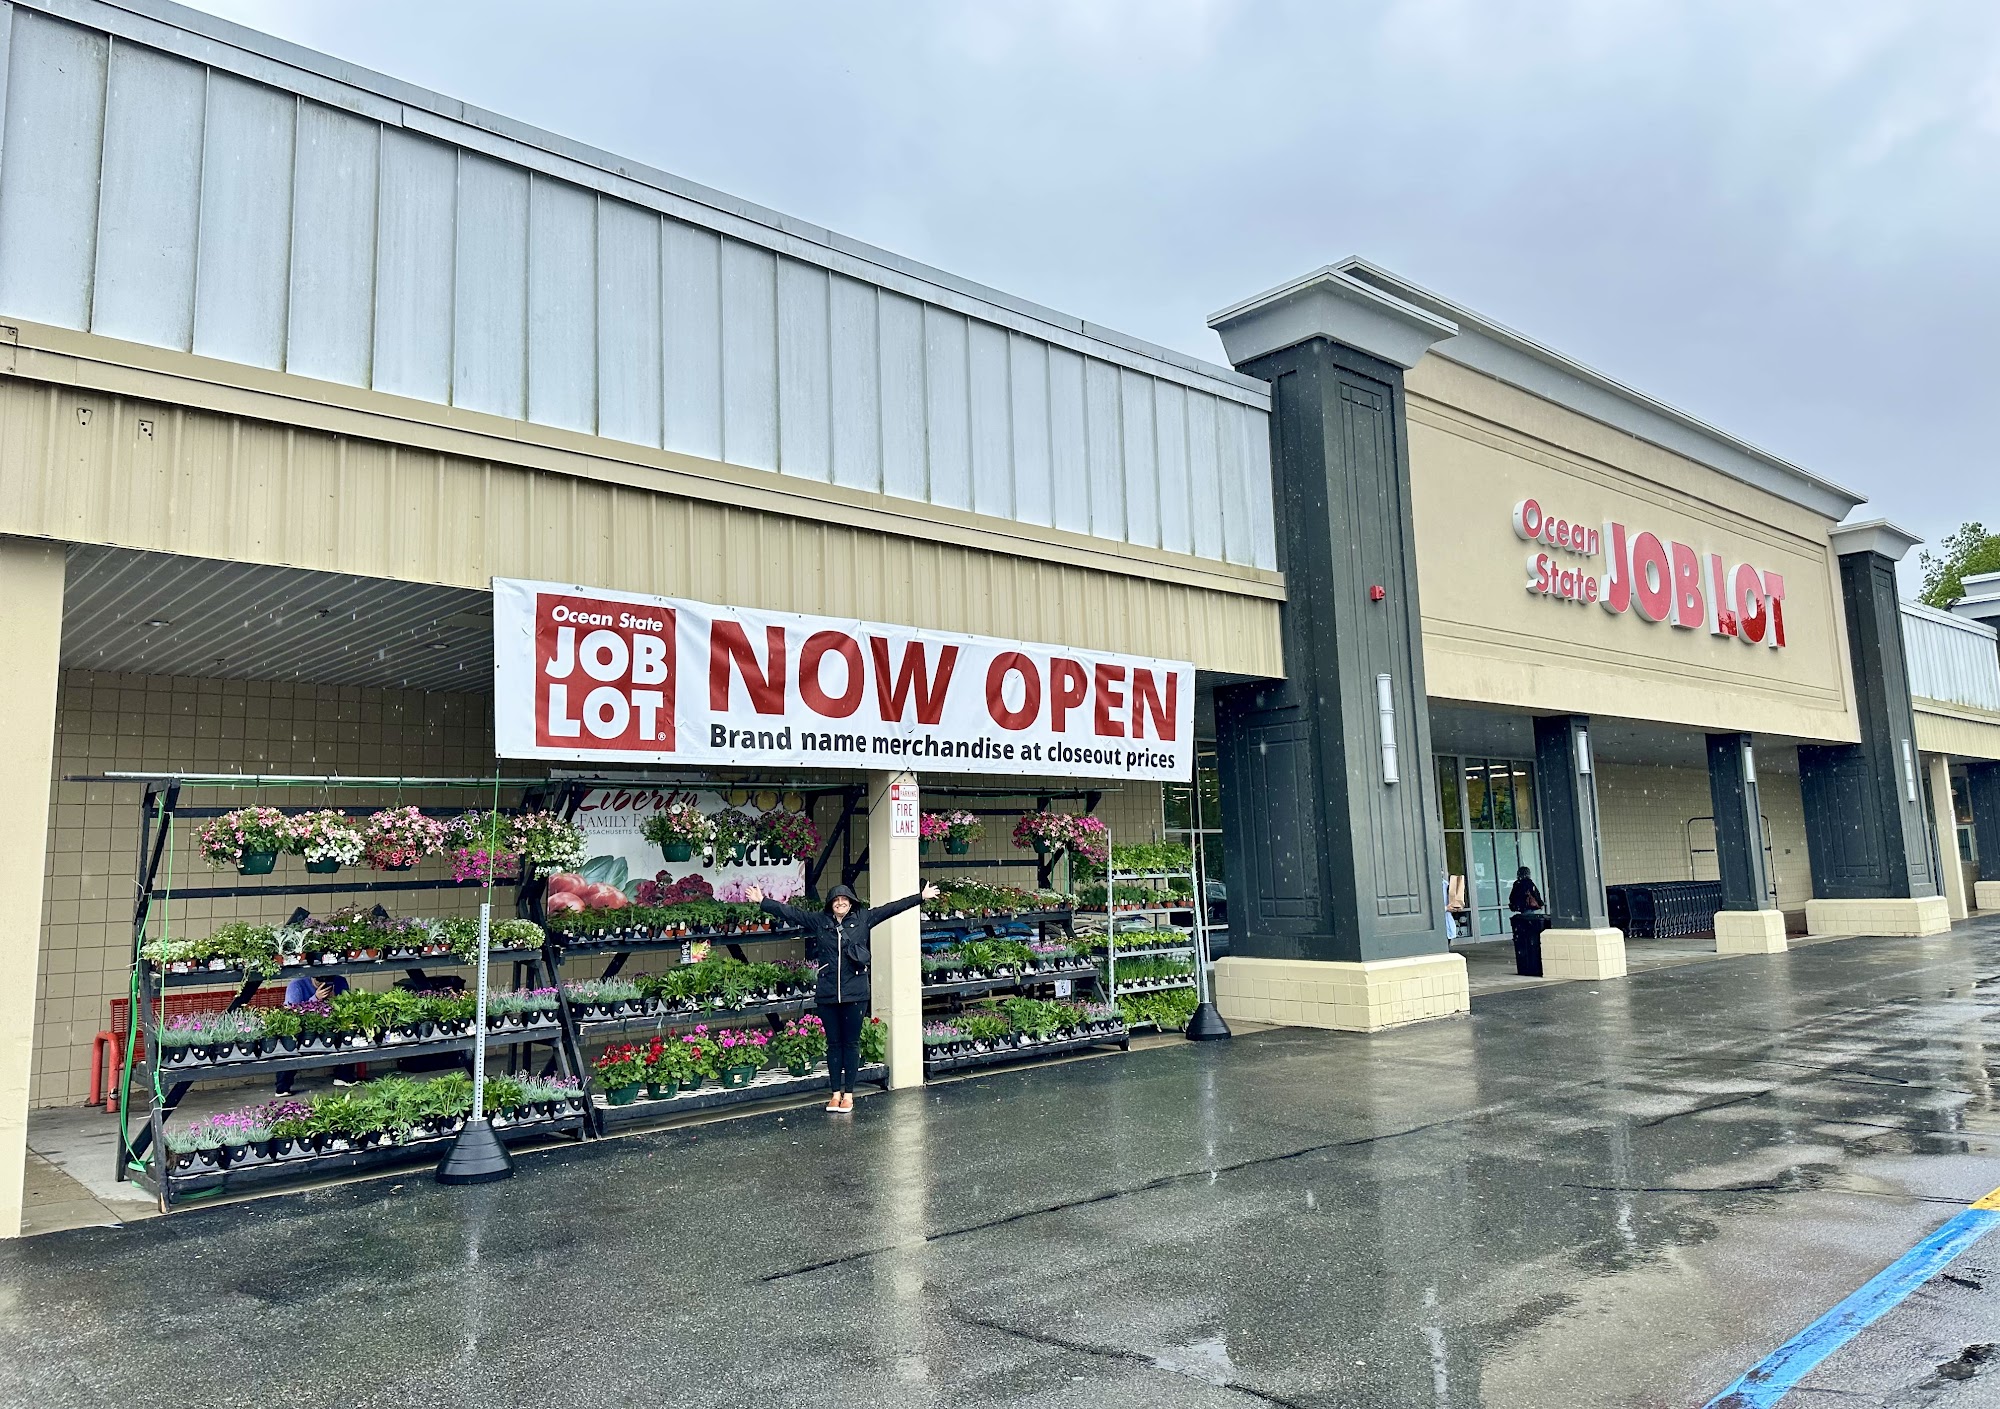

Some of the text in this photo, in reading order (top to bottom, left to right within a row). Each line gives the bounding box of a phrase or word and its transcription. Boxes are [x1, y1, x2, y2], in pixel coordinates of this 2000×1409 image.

[1515, 499, 1599, 555] Ocean
[1527, 553, 1597, 604] State
[1601, 522, 1786, 648] JOB LOT
[551, 605, 663, 632] Ocean State
[545, 626, 668, 685] JOB
[709, 619, 1177, 741] NOW OPEN
[710, 723, 1175, 771] Brand name merchandise at closeout prices
[896, 803, 913, 817] FIRE
[900, 790, 917, 798] PARKING
[895, 820, 915, 834] LANE
